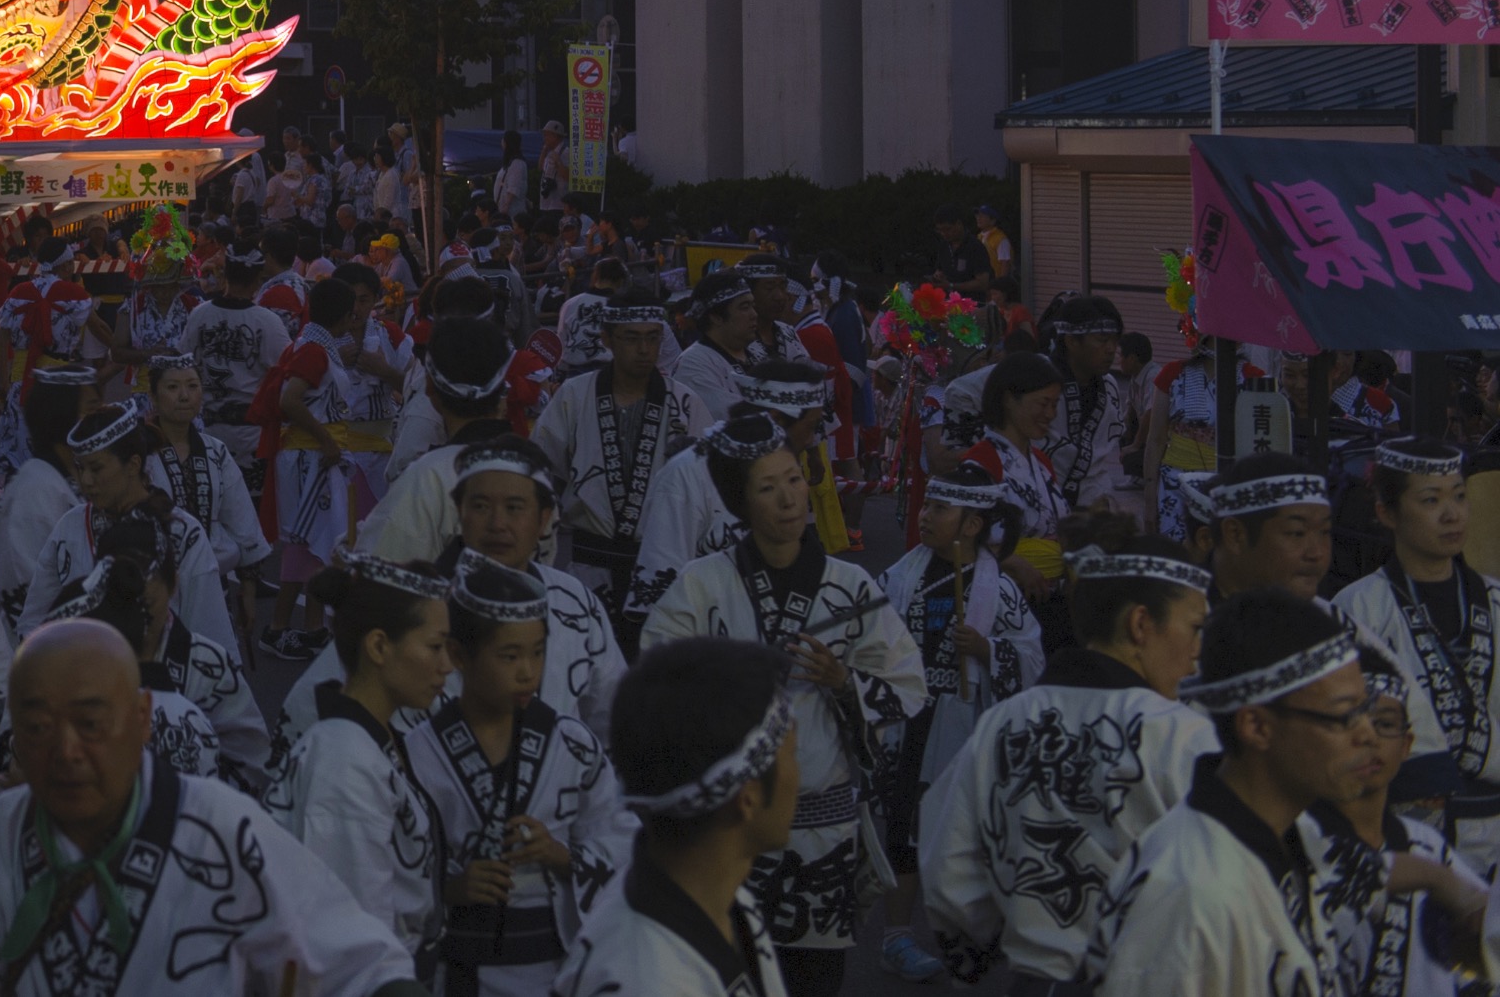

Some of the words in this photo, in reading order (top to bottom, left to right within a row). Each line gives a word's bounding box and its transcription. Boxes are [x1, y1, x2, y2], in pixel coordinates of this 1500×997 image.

[0, 171, 104, 198] 野菜で健康
[139, 179, 189, 197] 大作戦
